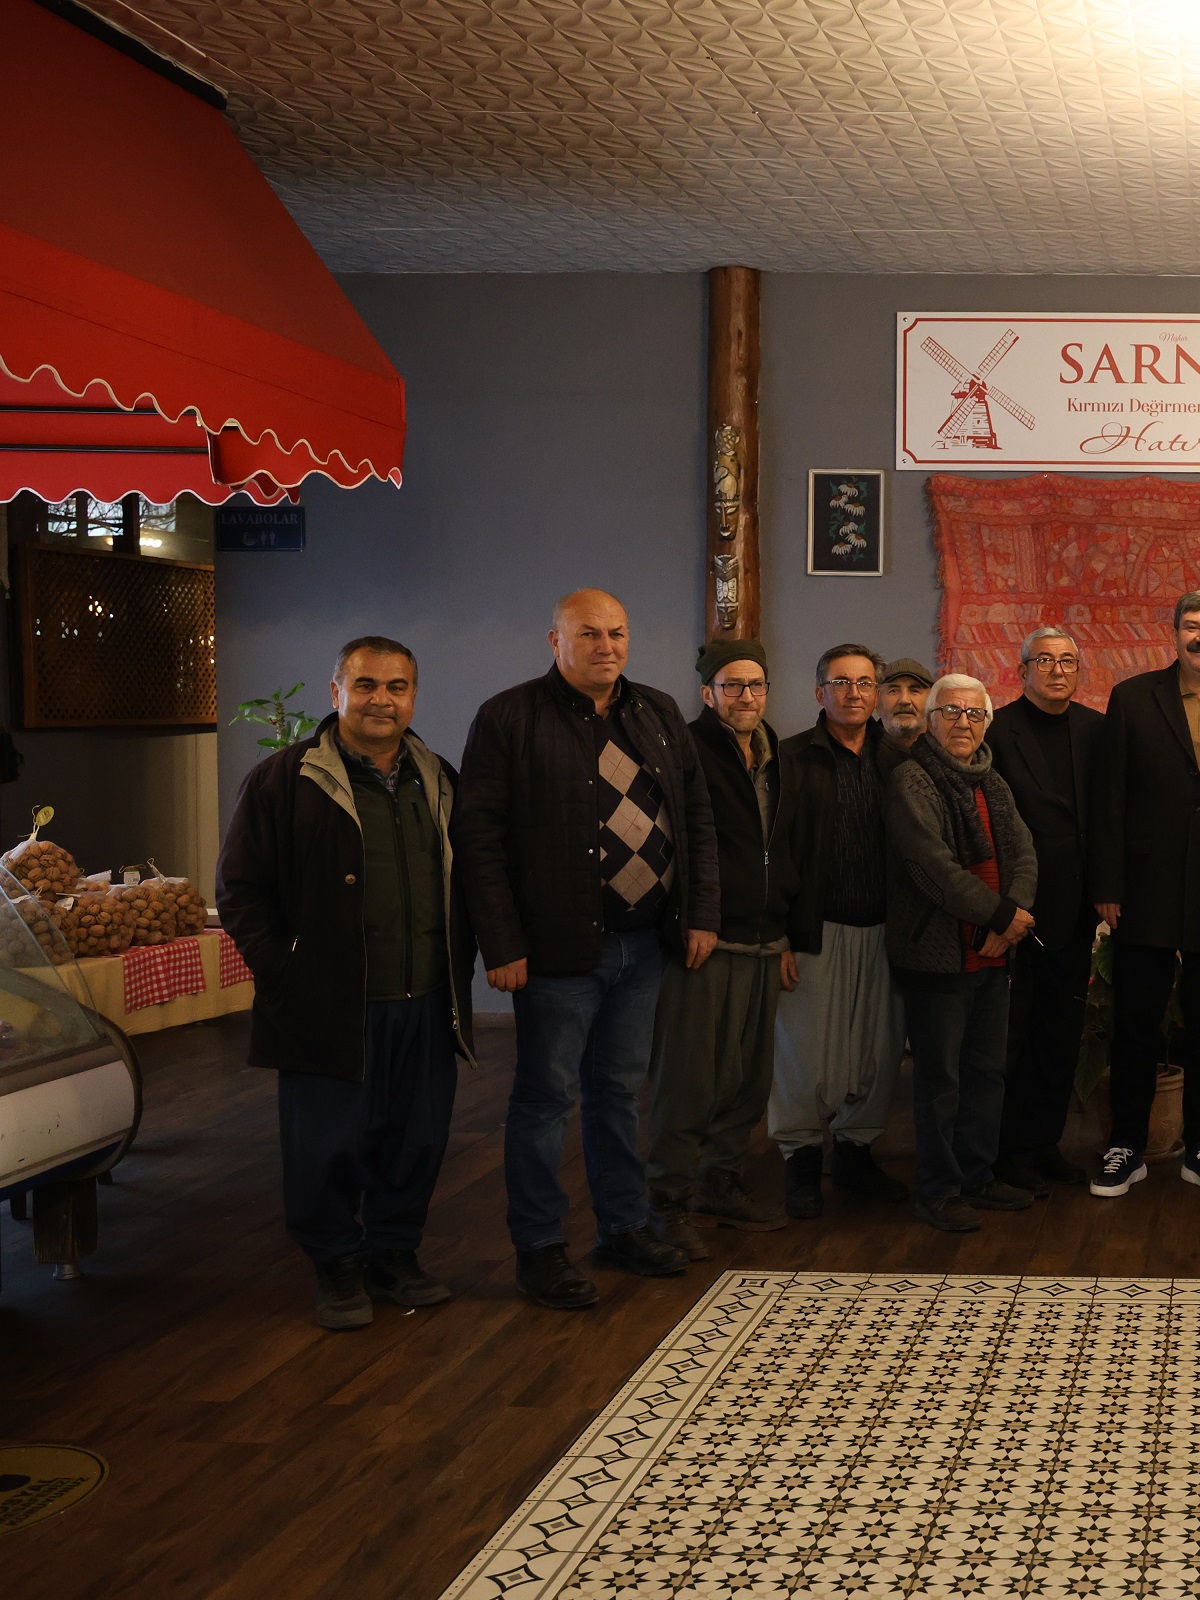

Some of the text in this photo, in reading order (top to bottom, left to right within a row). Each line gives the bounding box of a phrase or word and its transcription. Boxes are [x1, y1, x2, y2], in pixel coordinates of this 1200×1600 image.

[1067, 398, 1125, 413] Kırmızı
[221, 513, 299, 525] LAVABOLAR
[0, 1478, 58, 1514] OSYAL
